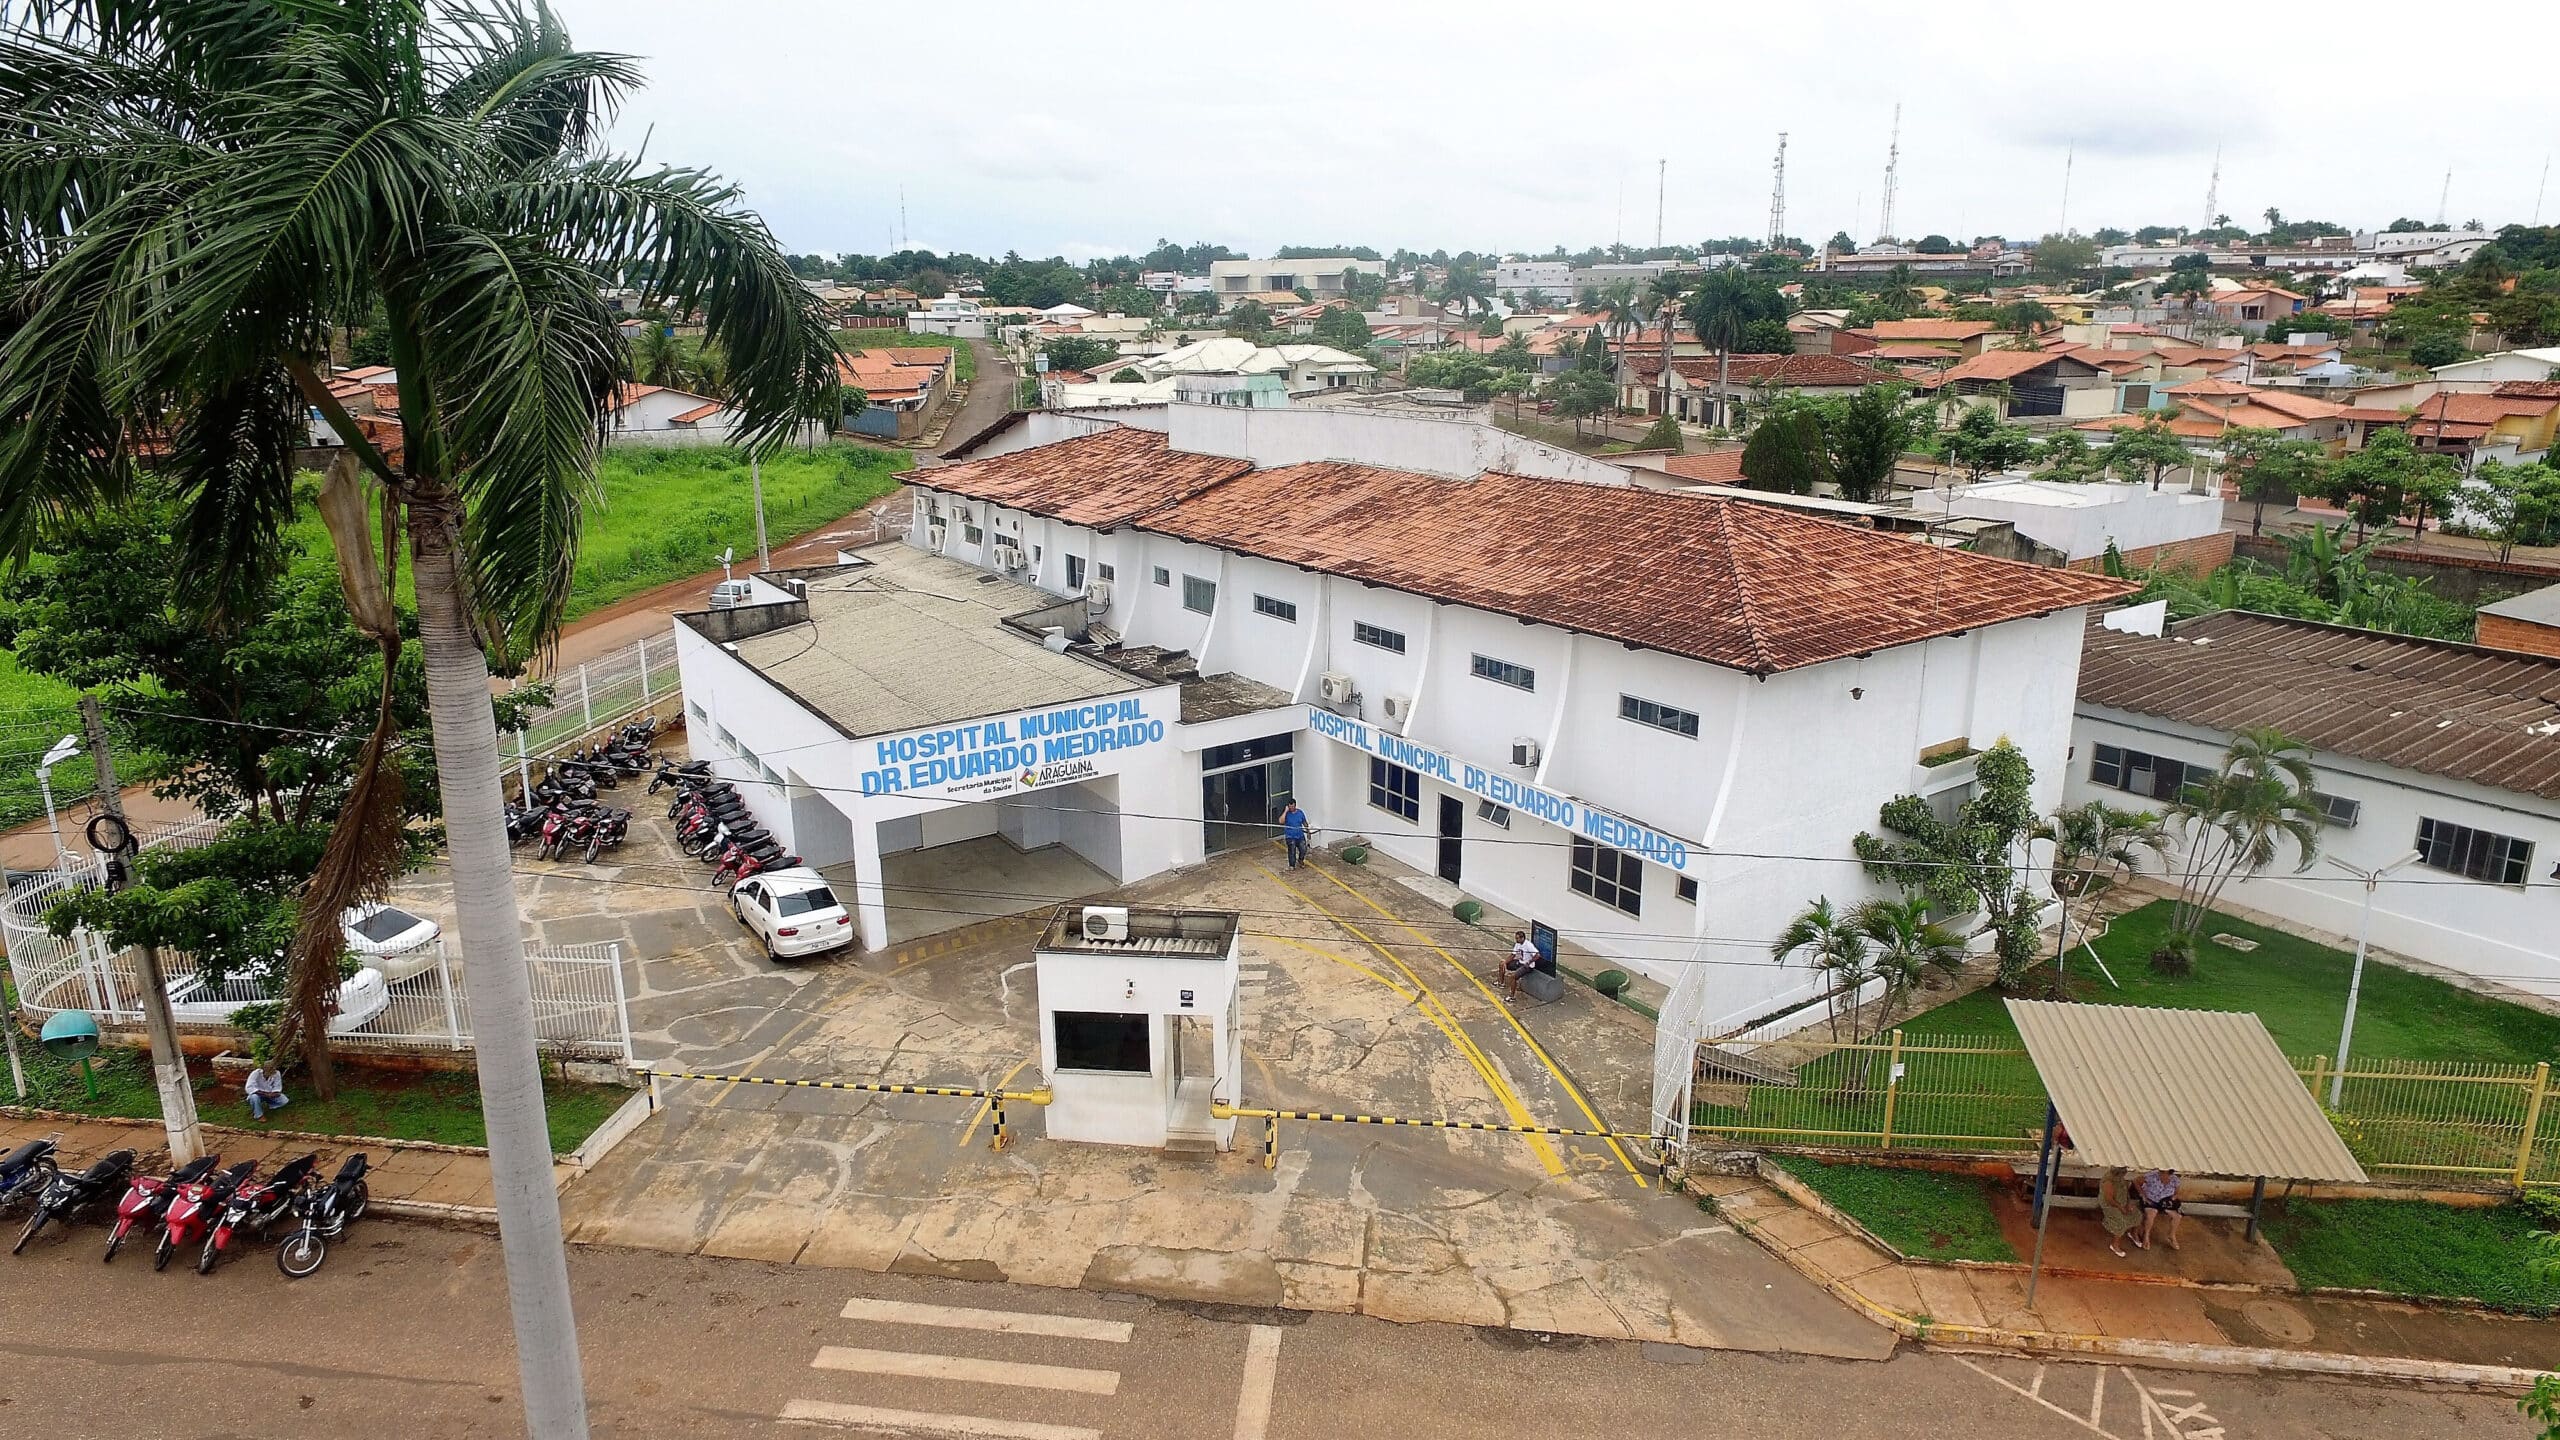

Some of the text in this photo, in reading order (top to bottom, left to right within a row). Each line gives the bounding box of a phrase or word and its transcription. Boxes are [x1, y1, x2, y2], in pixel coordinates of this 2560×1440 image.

[877, 698, 1149, 766] HOSPITAL MUNICIPAL
[1044, 719, 1164, 763] MEDRADO
[1309, 708, 1372, 752] HOSPITAL
[1379, 734, 1456, 784] MUNICIPAL
[1583, 808, 1687, 870] MEDRADO
